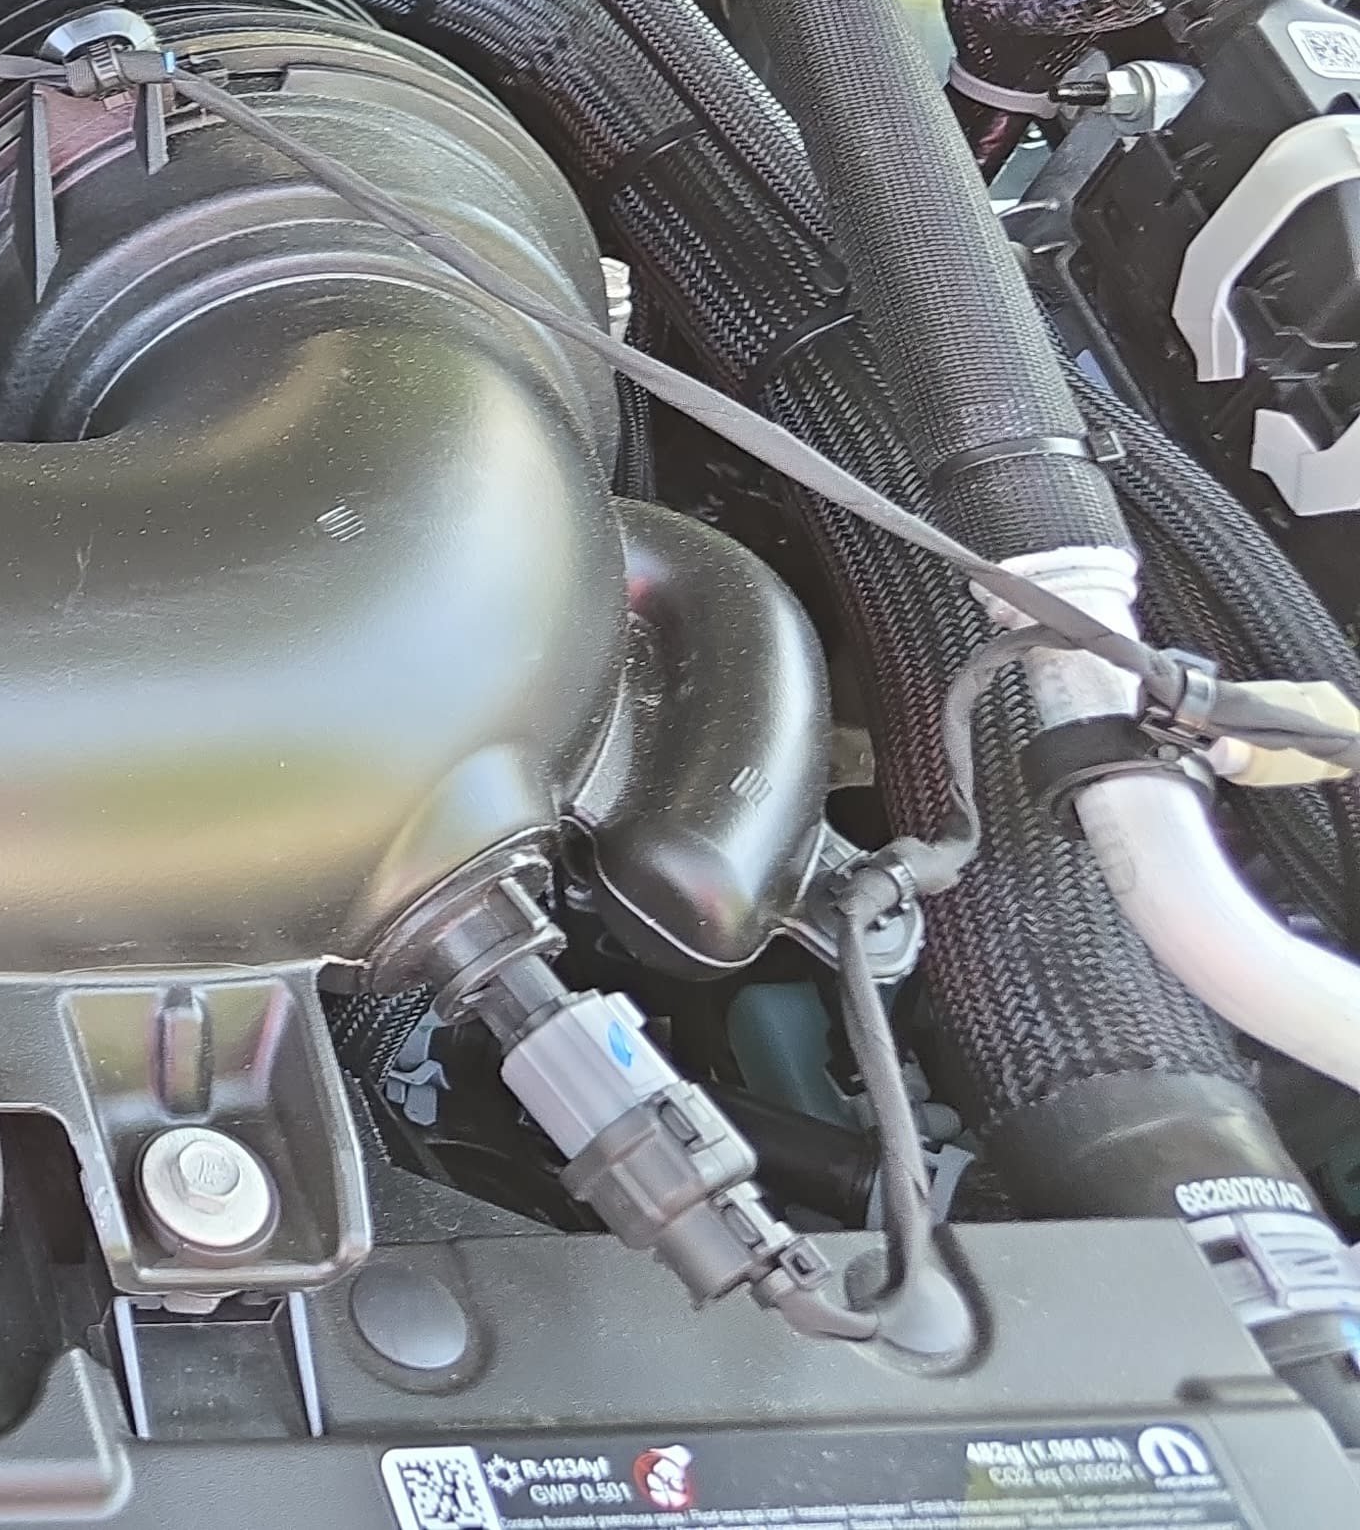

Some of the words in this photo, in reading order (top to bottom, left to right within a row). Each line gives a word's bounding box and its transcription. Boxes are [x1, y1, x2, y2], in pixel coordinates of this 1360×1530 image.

[520, 1457, 611, 1482] R-1234yf
[529, 1482, 579, 1506] GWP
[580, 1481, 632, 1504] 0.501
